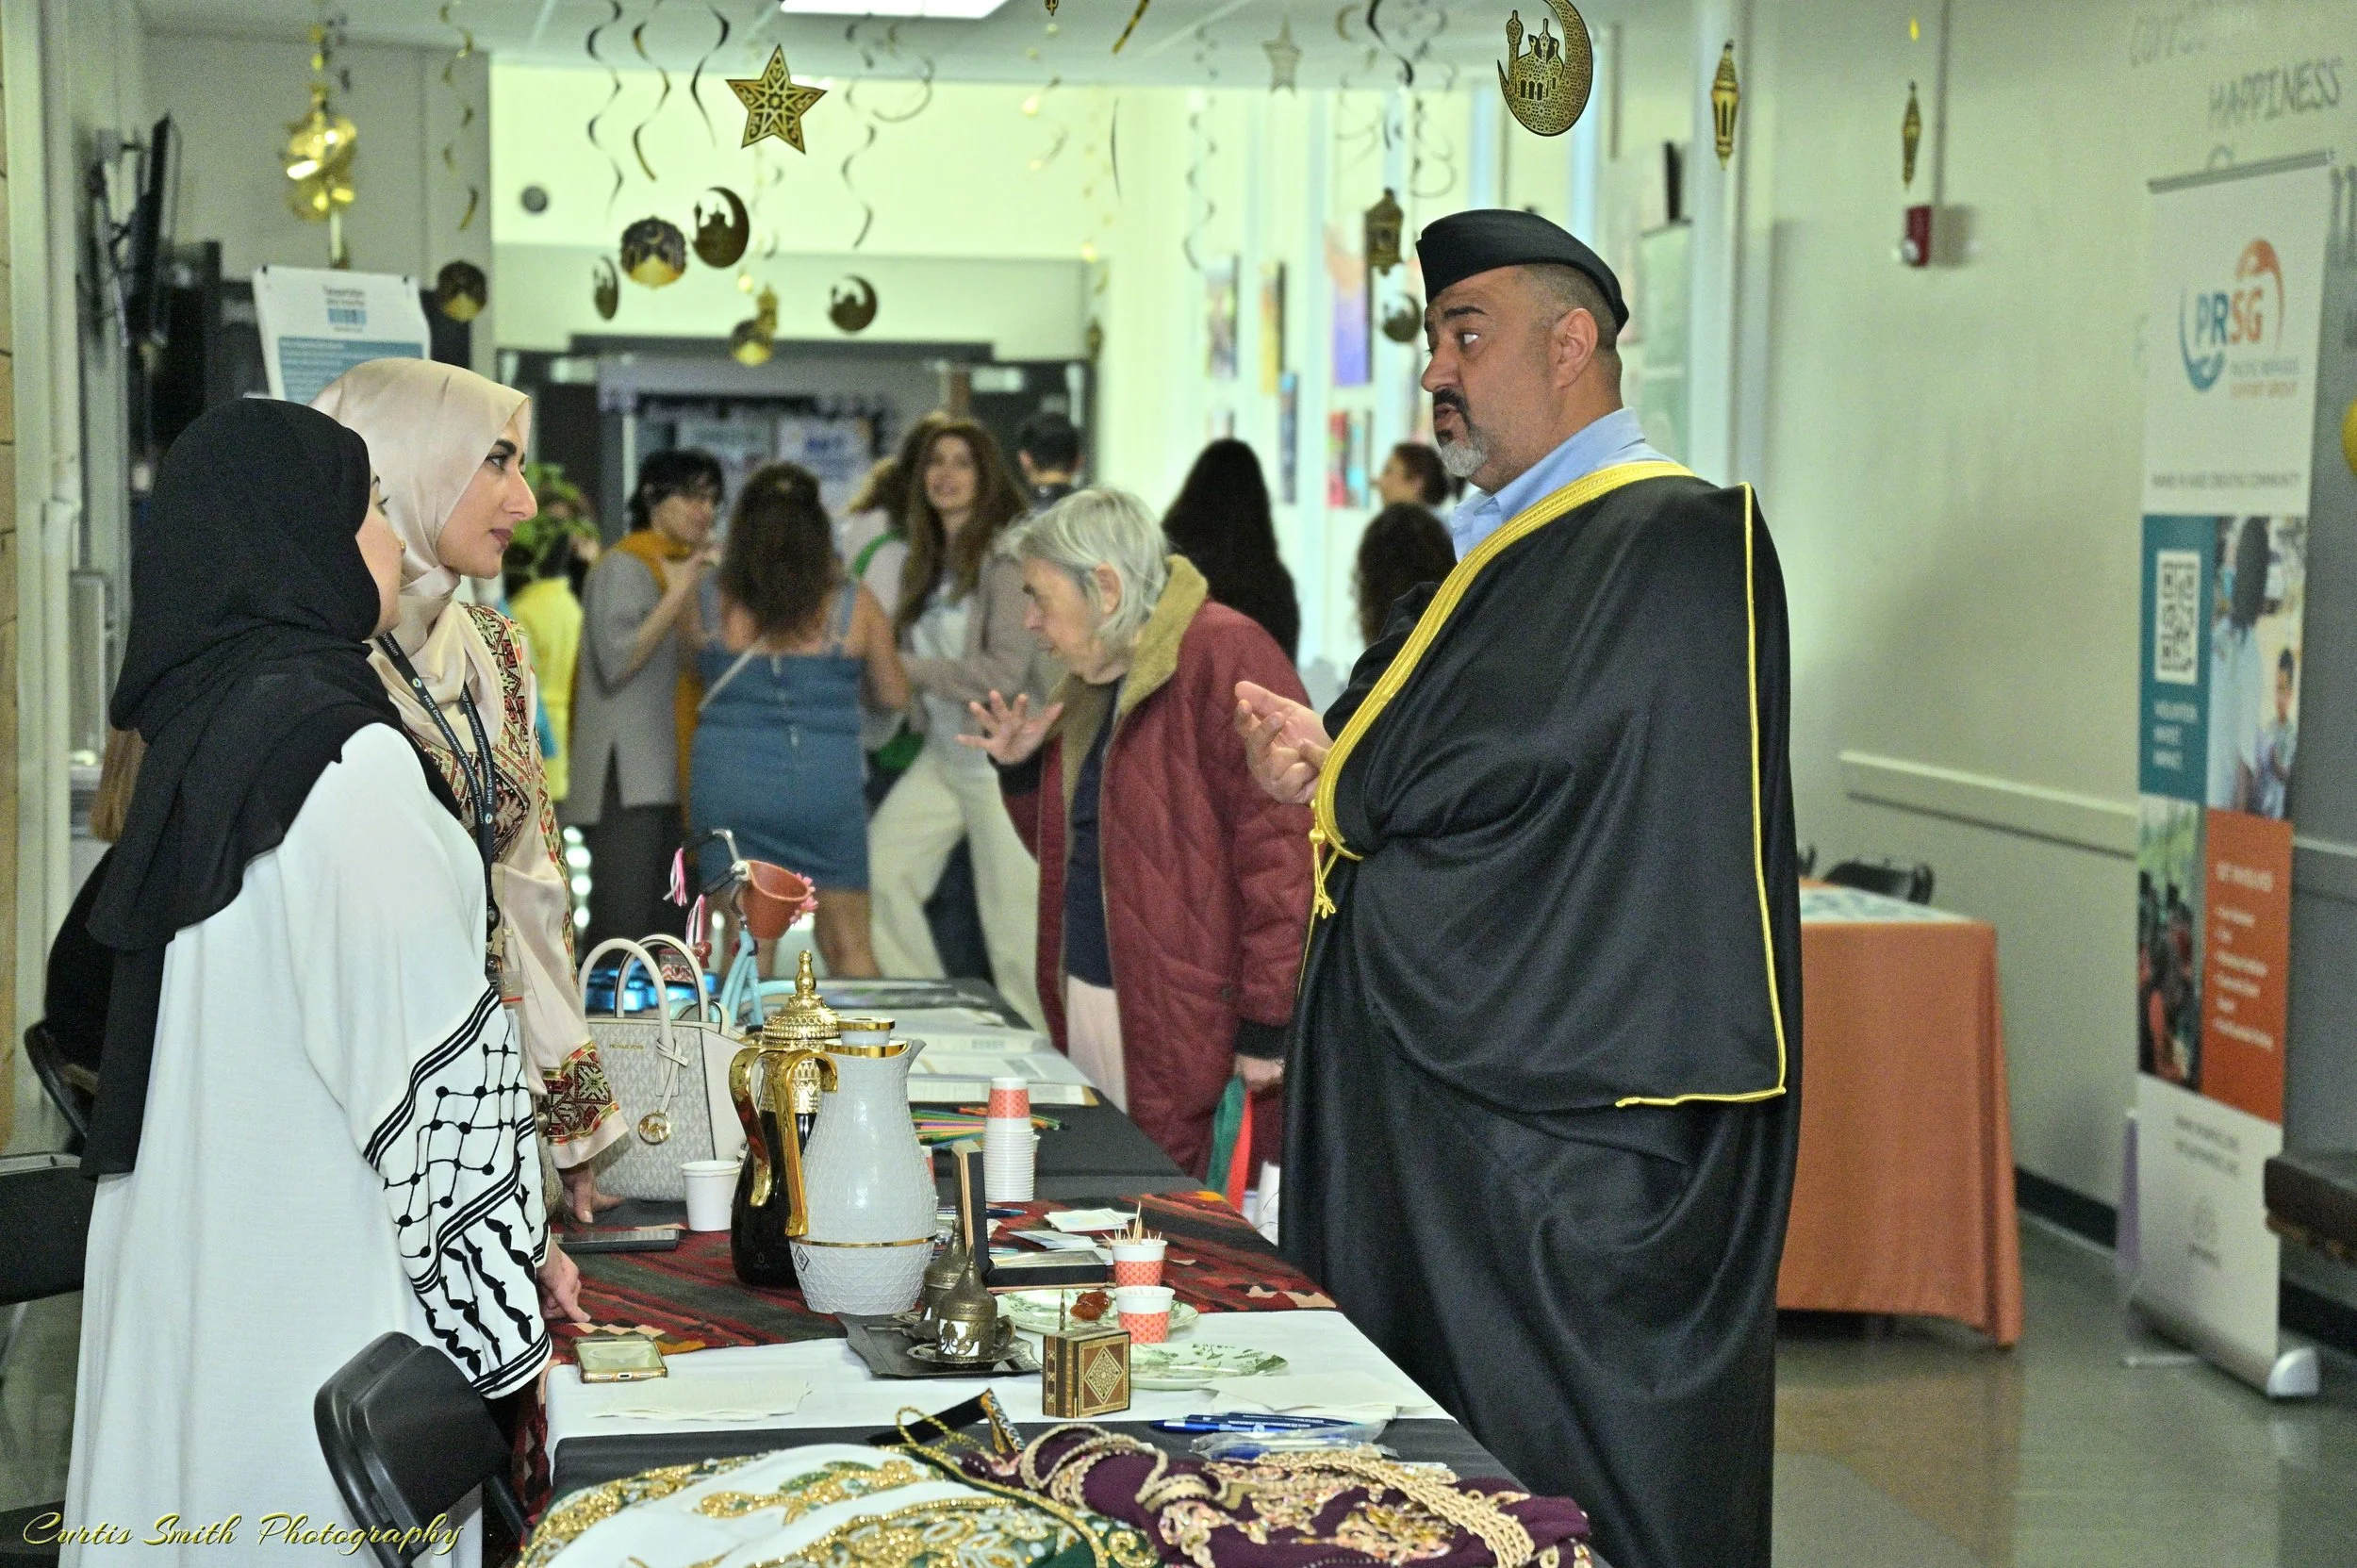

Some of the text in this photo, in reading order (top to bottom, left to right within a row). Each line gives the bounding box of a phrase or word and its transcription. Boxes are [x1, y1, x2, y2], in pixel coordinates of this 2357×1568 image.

[2208, 55, 2344, 130] HAPPINESS
[2194, 287, 2264, 347] PRSG
[466, 701, 482, 736] Disabilities
[423, 694, 485, 824] HHS Developmental Disabilities Division
[477, 736, 493, 788] Developmental
